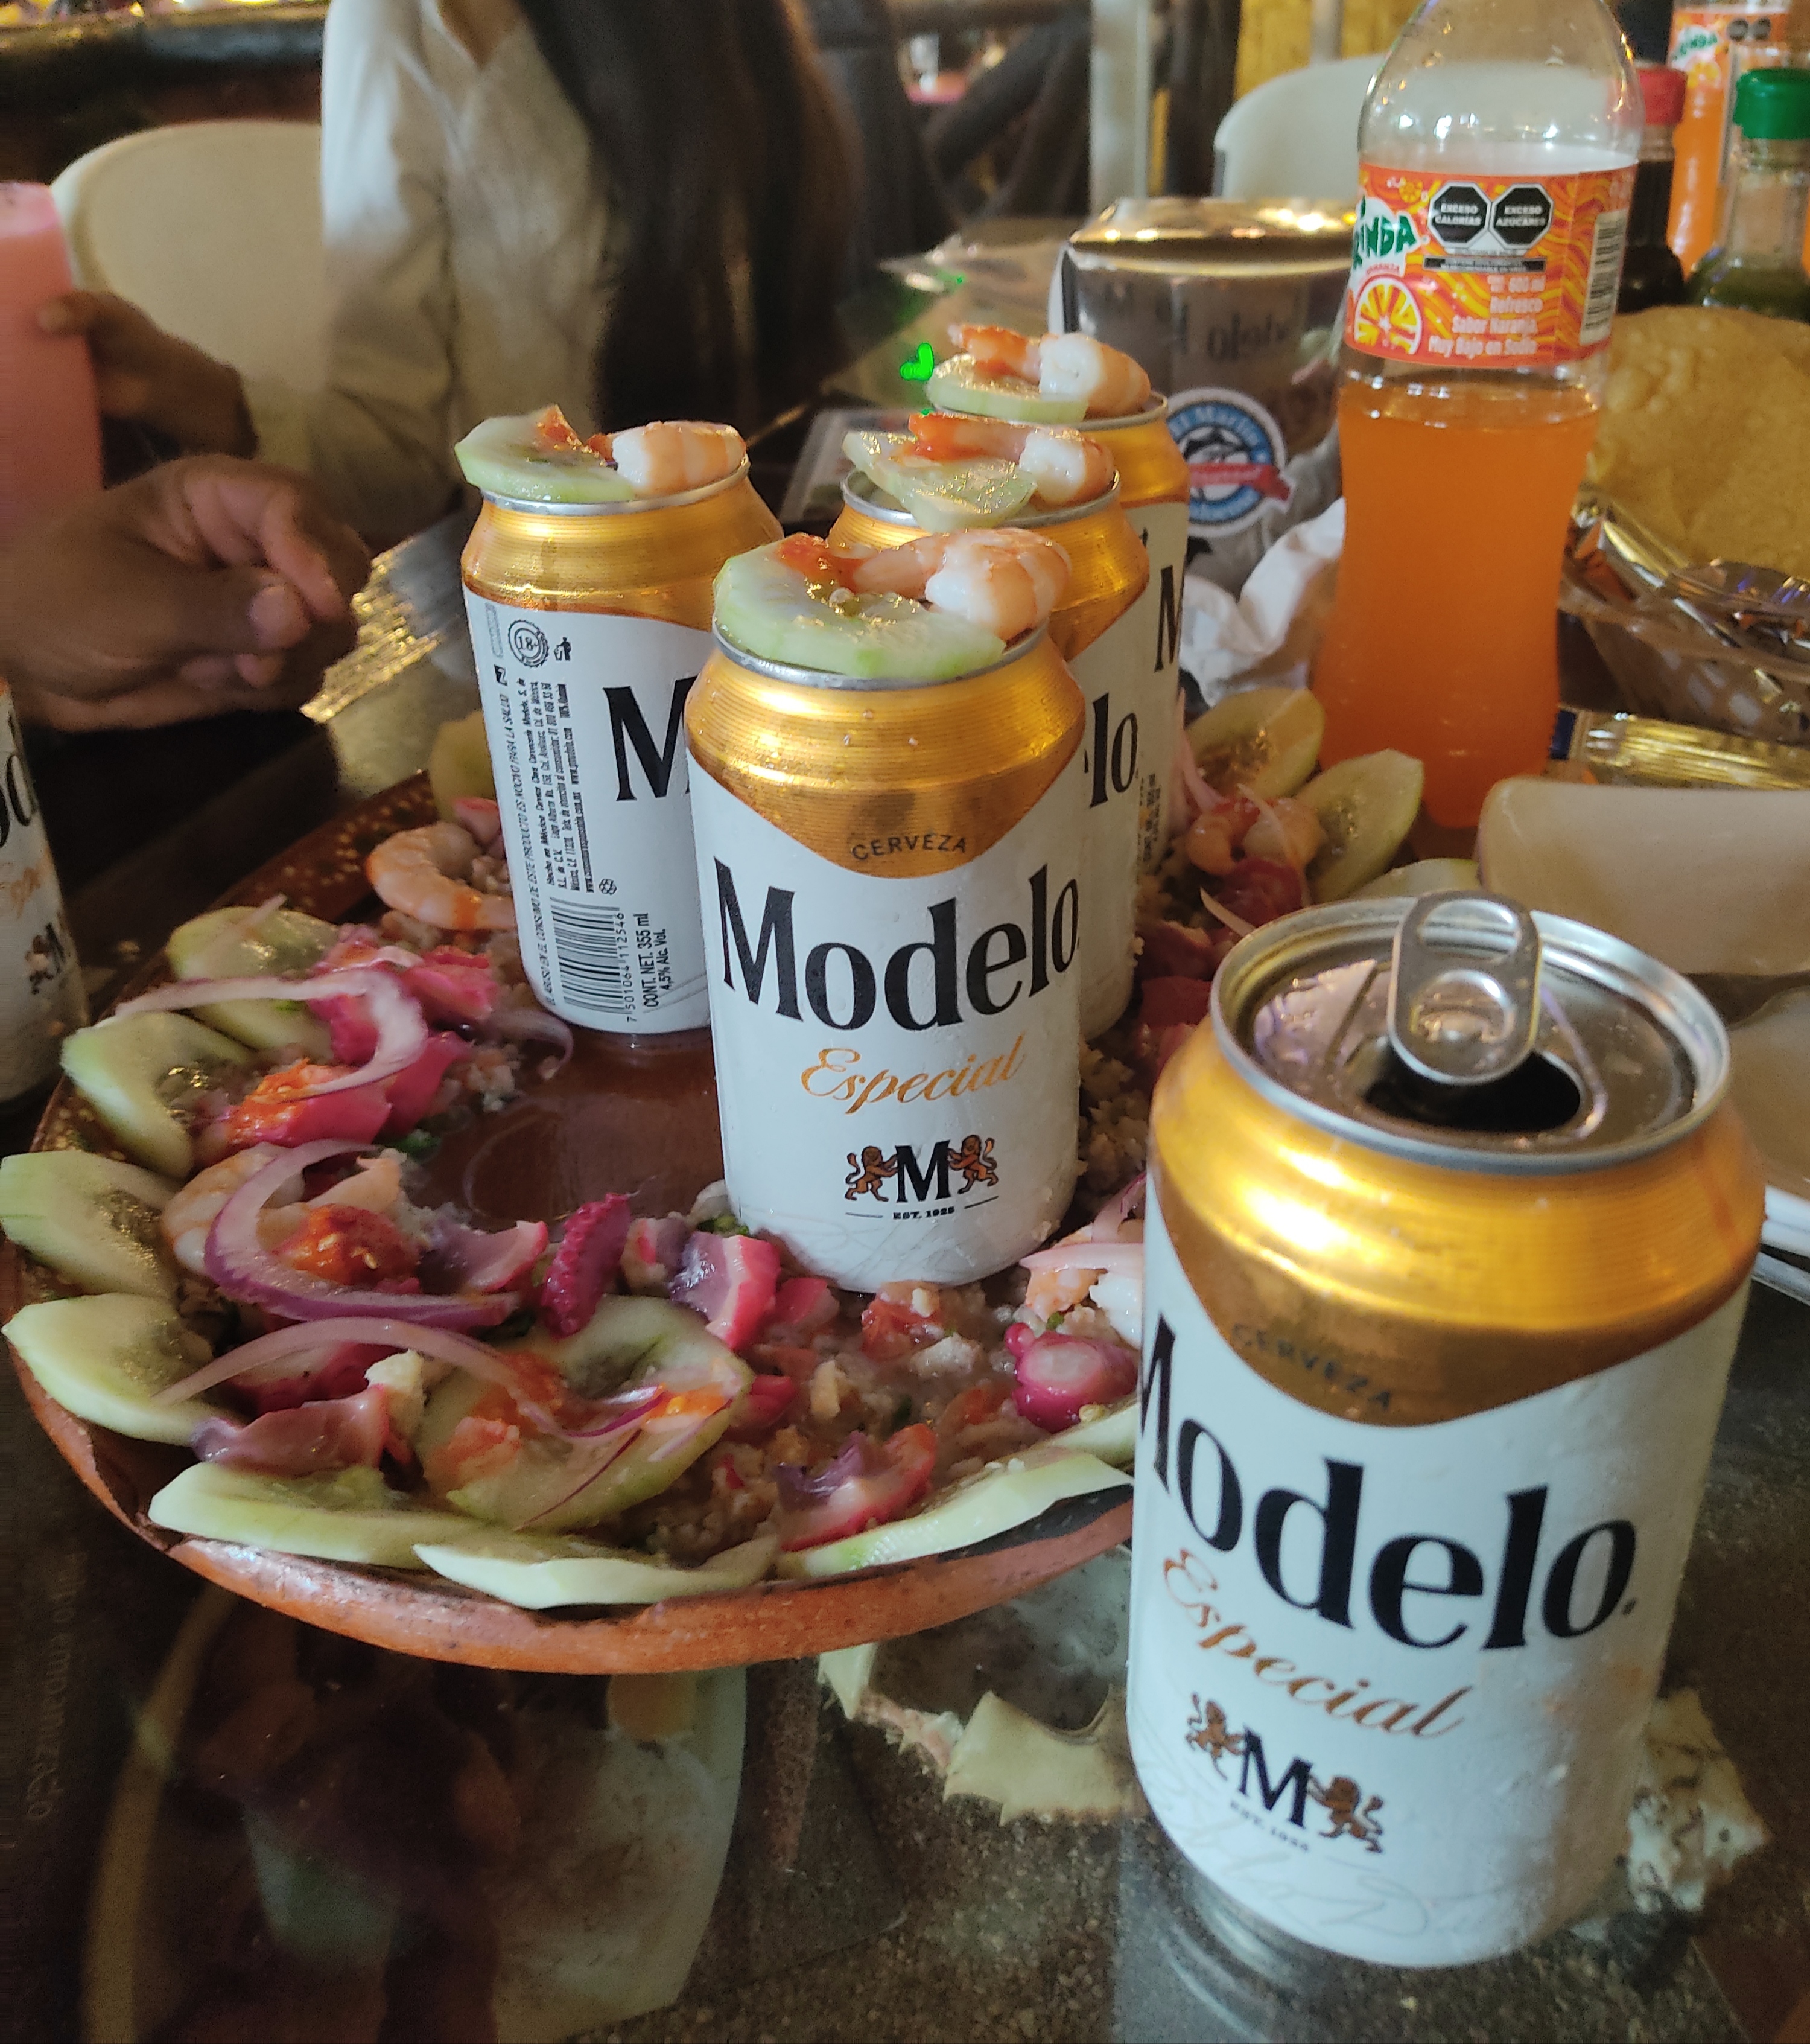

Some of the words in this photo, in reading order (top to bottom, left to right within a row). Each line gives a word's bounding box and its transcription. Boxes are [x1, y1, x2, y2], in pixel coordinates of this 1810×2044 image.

[851, 833, 965, 861] CERVEZA
[633, 912, 650, 926] ml
[635, 930, 652, 949] 355
[714, 856, 1079, 1031] Modelo
[638, 952, 656, 974] NET.
[641, 978, 659, 1007] CONT.
[801, 1032, 1027, 1115] Especial
[1232, 1323, 1392, 1410] CERVEZA
[1141, 1312, 1636, 1651] Modelo
[1163, 1547, 1473, 1737] Especial
